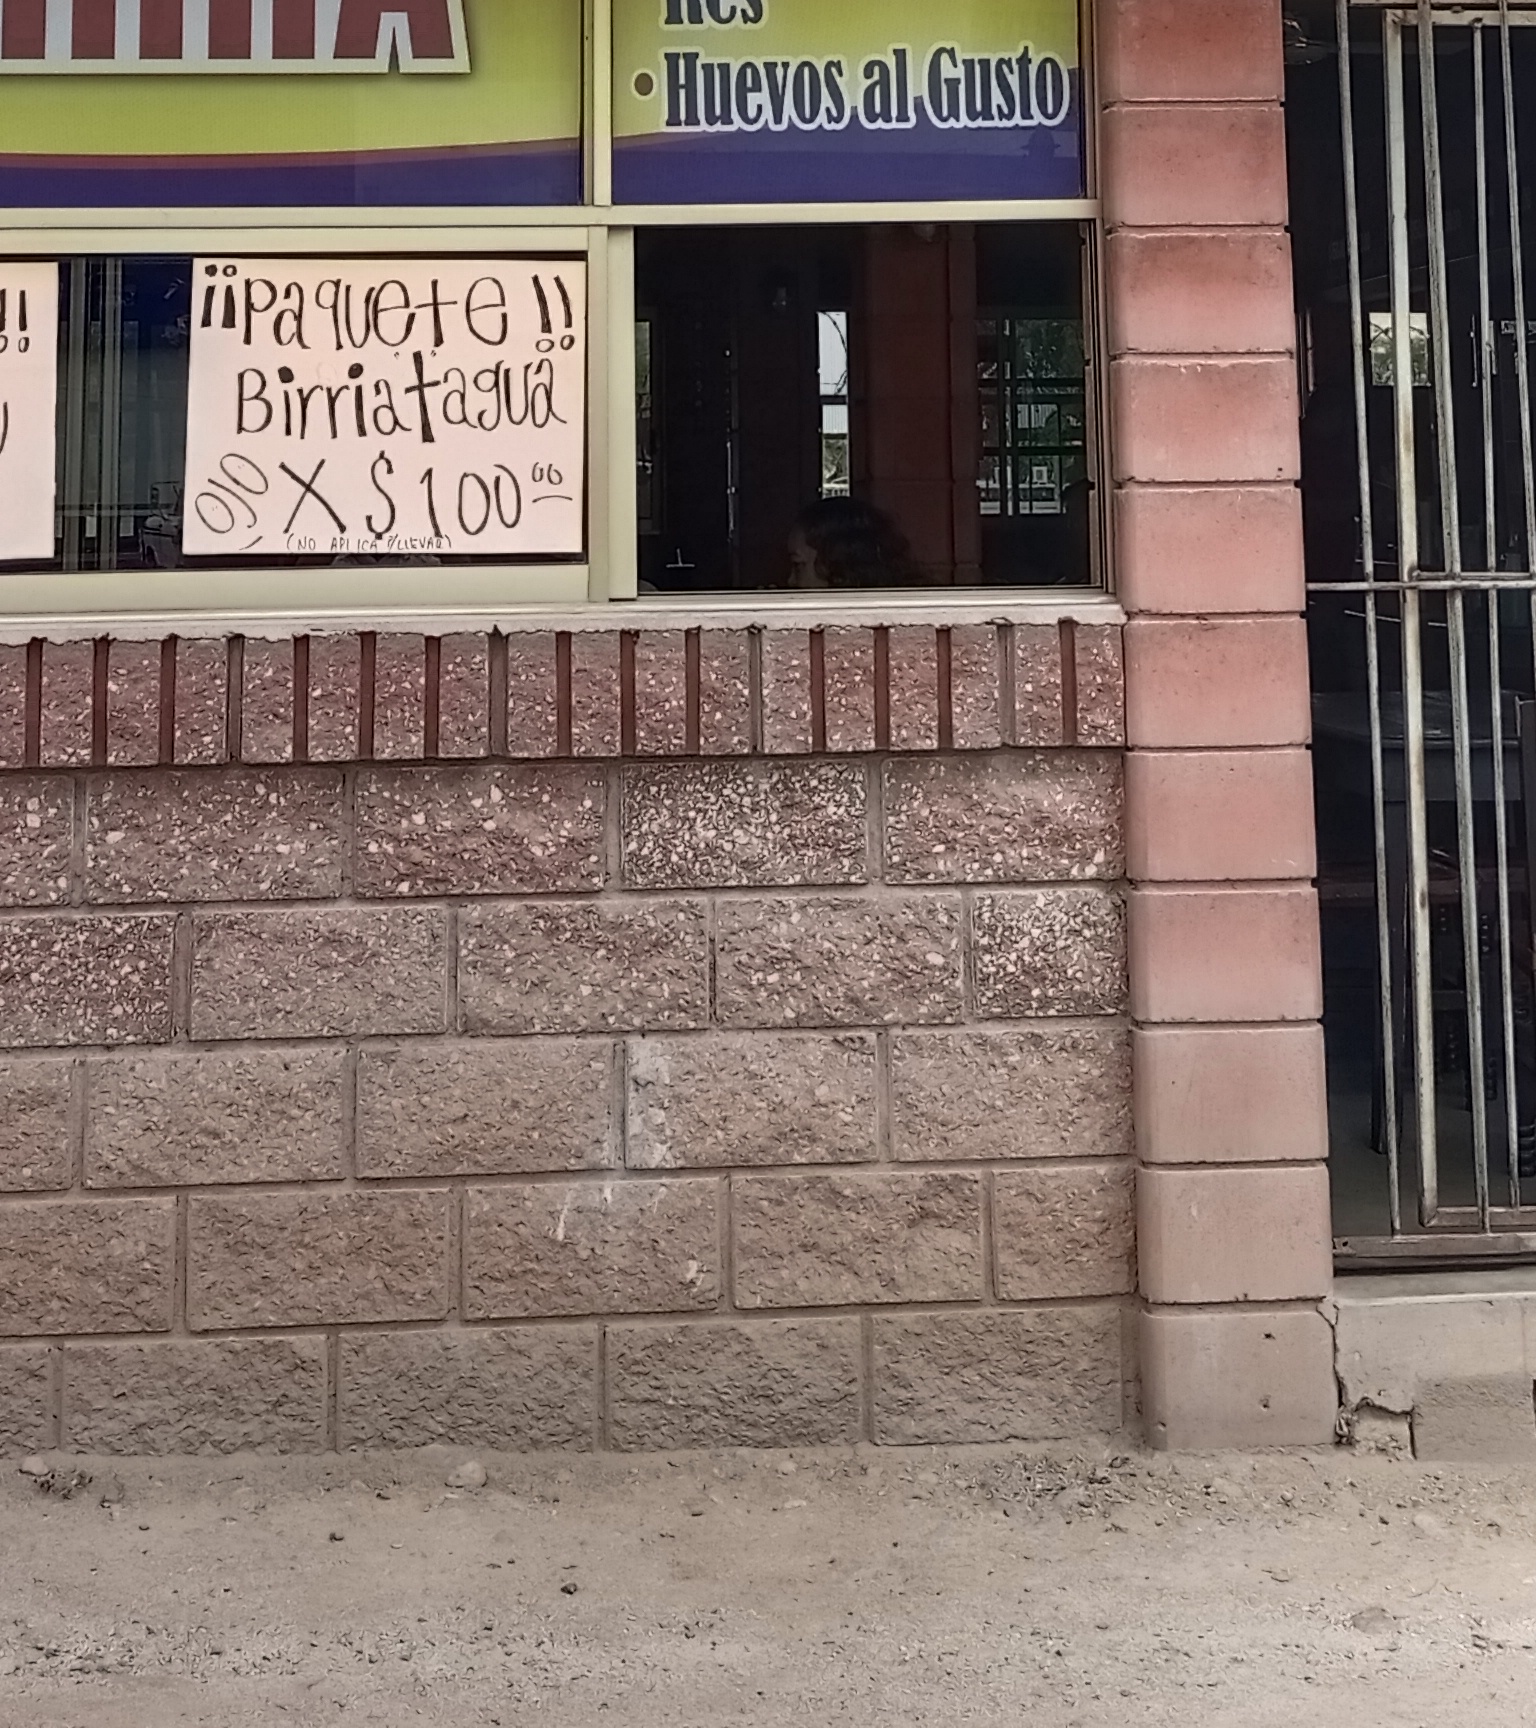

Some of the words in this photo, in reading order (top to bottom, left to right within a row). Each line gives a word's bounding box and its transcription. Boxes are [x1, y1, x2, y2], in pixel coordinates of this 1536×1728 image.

[663, 50, 847, 128] Huevos
[863, 47, 912, 125] al
[927, 45, 1067, 125] Gusto
[278, 457, 348, 535] X
